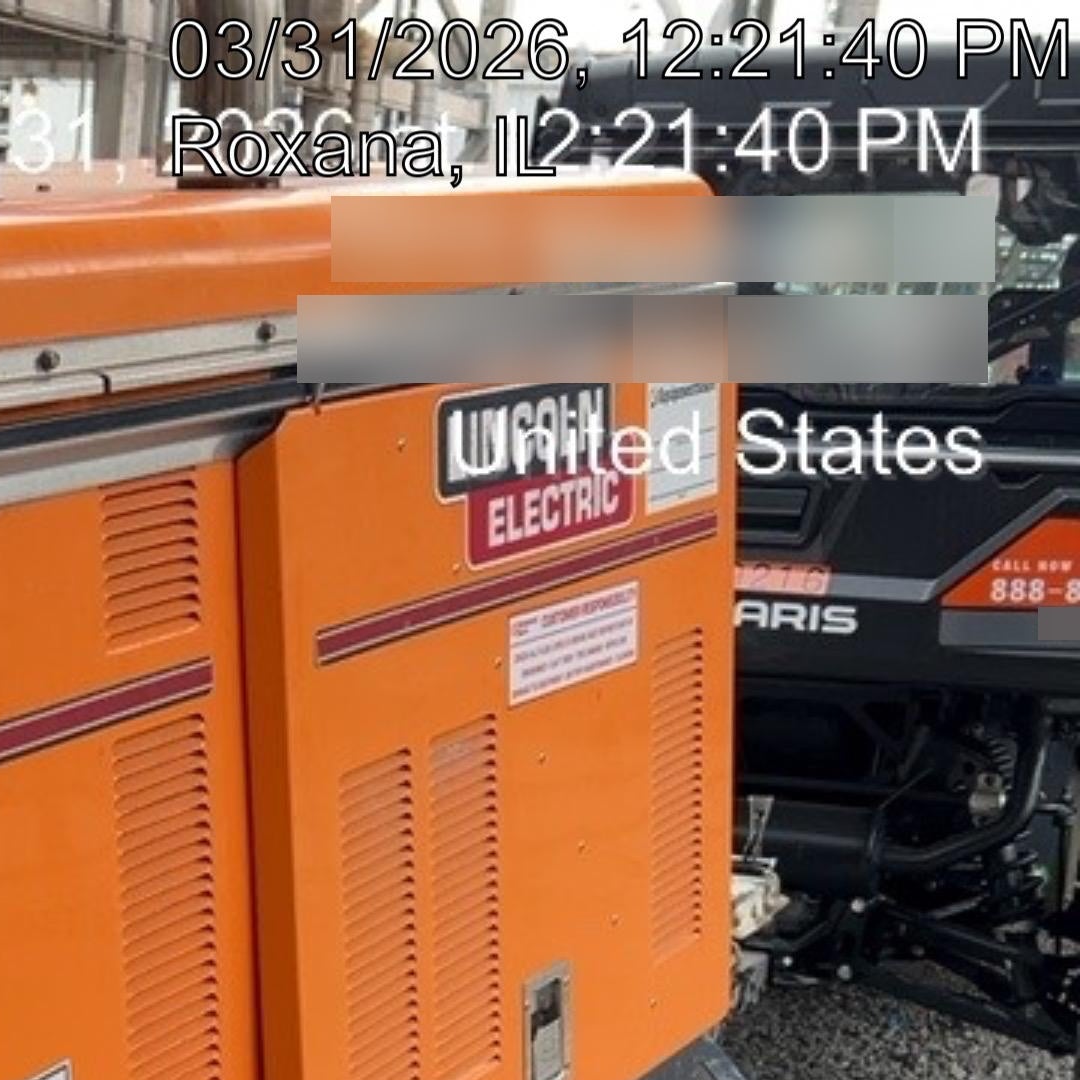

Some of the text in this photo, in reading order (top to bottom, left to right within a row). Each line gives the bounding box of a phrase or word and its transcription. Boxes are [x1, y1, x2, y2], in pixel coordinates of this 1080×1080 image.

[488, 470, 620, 548] ELECTRIC
[991, 559, 1073, 573] CALL NOW
[734, 599, 858, 633] ARIS
